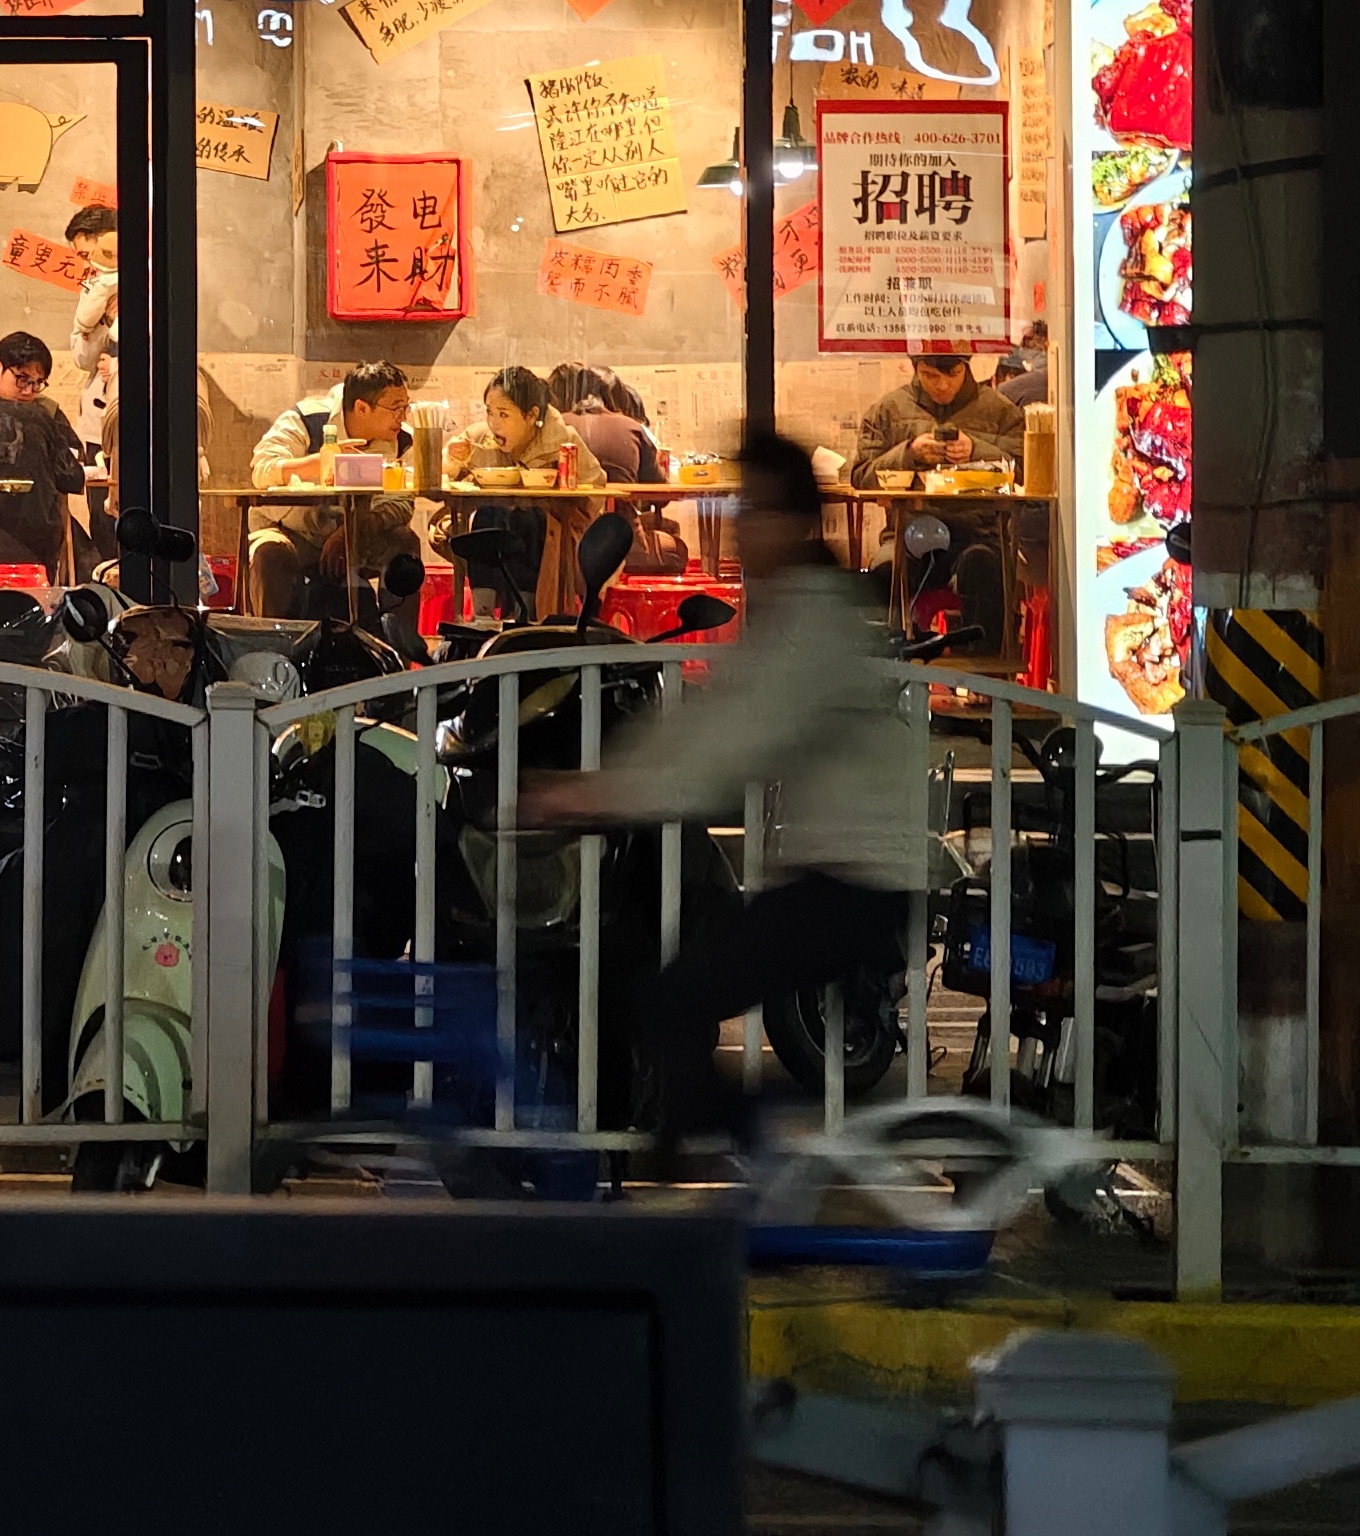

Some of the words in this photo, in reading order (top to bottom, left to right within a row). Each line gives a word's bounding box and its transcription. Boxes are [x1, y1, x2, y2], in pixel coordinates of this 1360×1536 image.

[196, 137, 252, 164] 的传承
[913, 131, 1002, 146] 400-626-3701
[551, 138, 666, 176] 你一定从别人
[869, 153, 957, 168] 期待你的加入
[852, 169, 974, 226] 招聘
